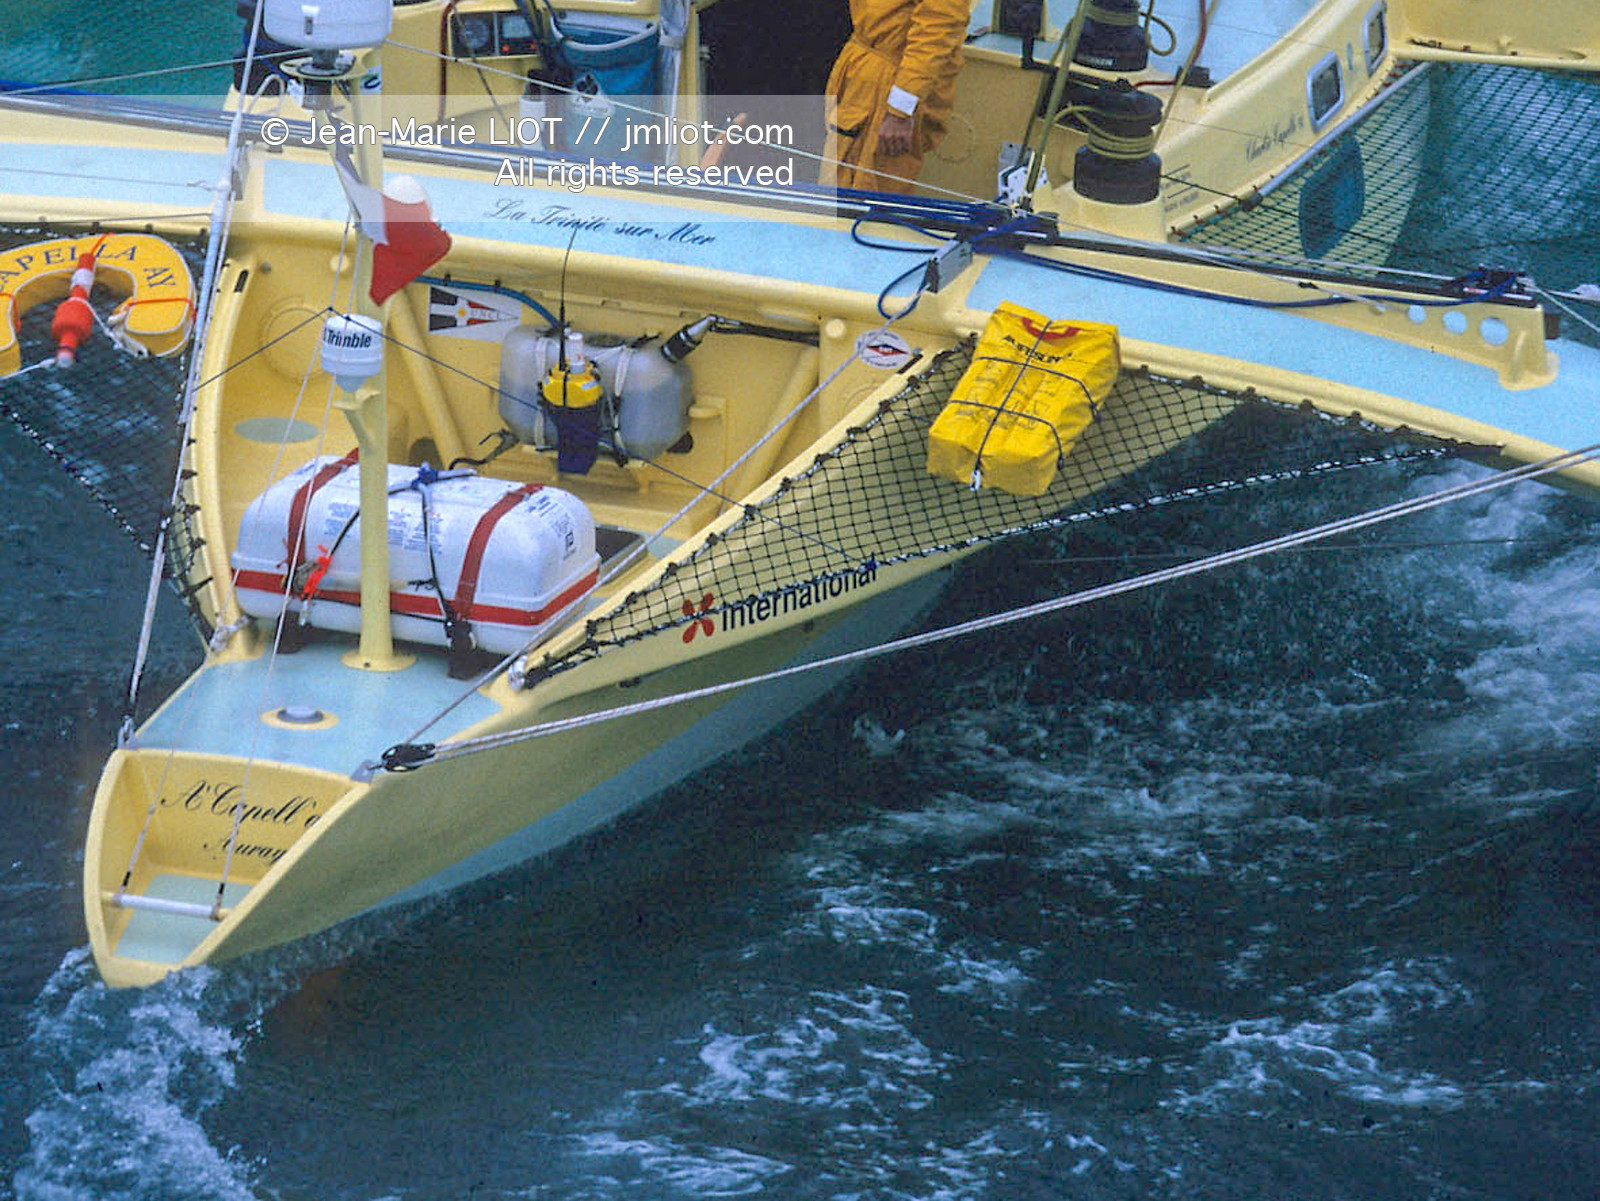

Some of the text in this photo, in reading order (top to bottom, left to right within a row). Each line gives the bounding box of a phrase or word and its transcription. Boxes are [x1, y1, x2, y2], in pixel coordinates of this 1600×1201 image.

[484, 198, 526, 221] La
[614, 221, 654, 237] sur
[654, 221, 716, 246] Mer
[0, 243, 137, 292] APELLA
[327, 327, 372, 349] Trimble
